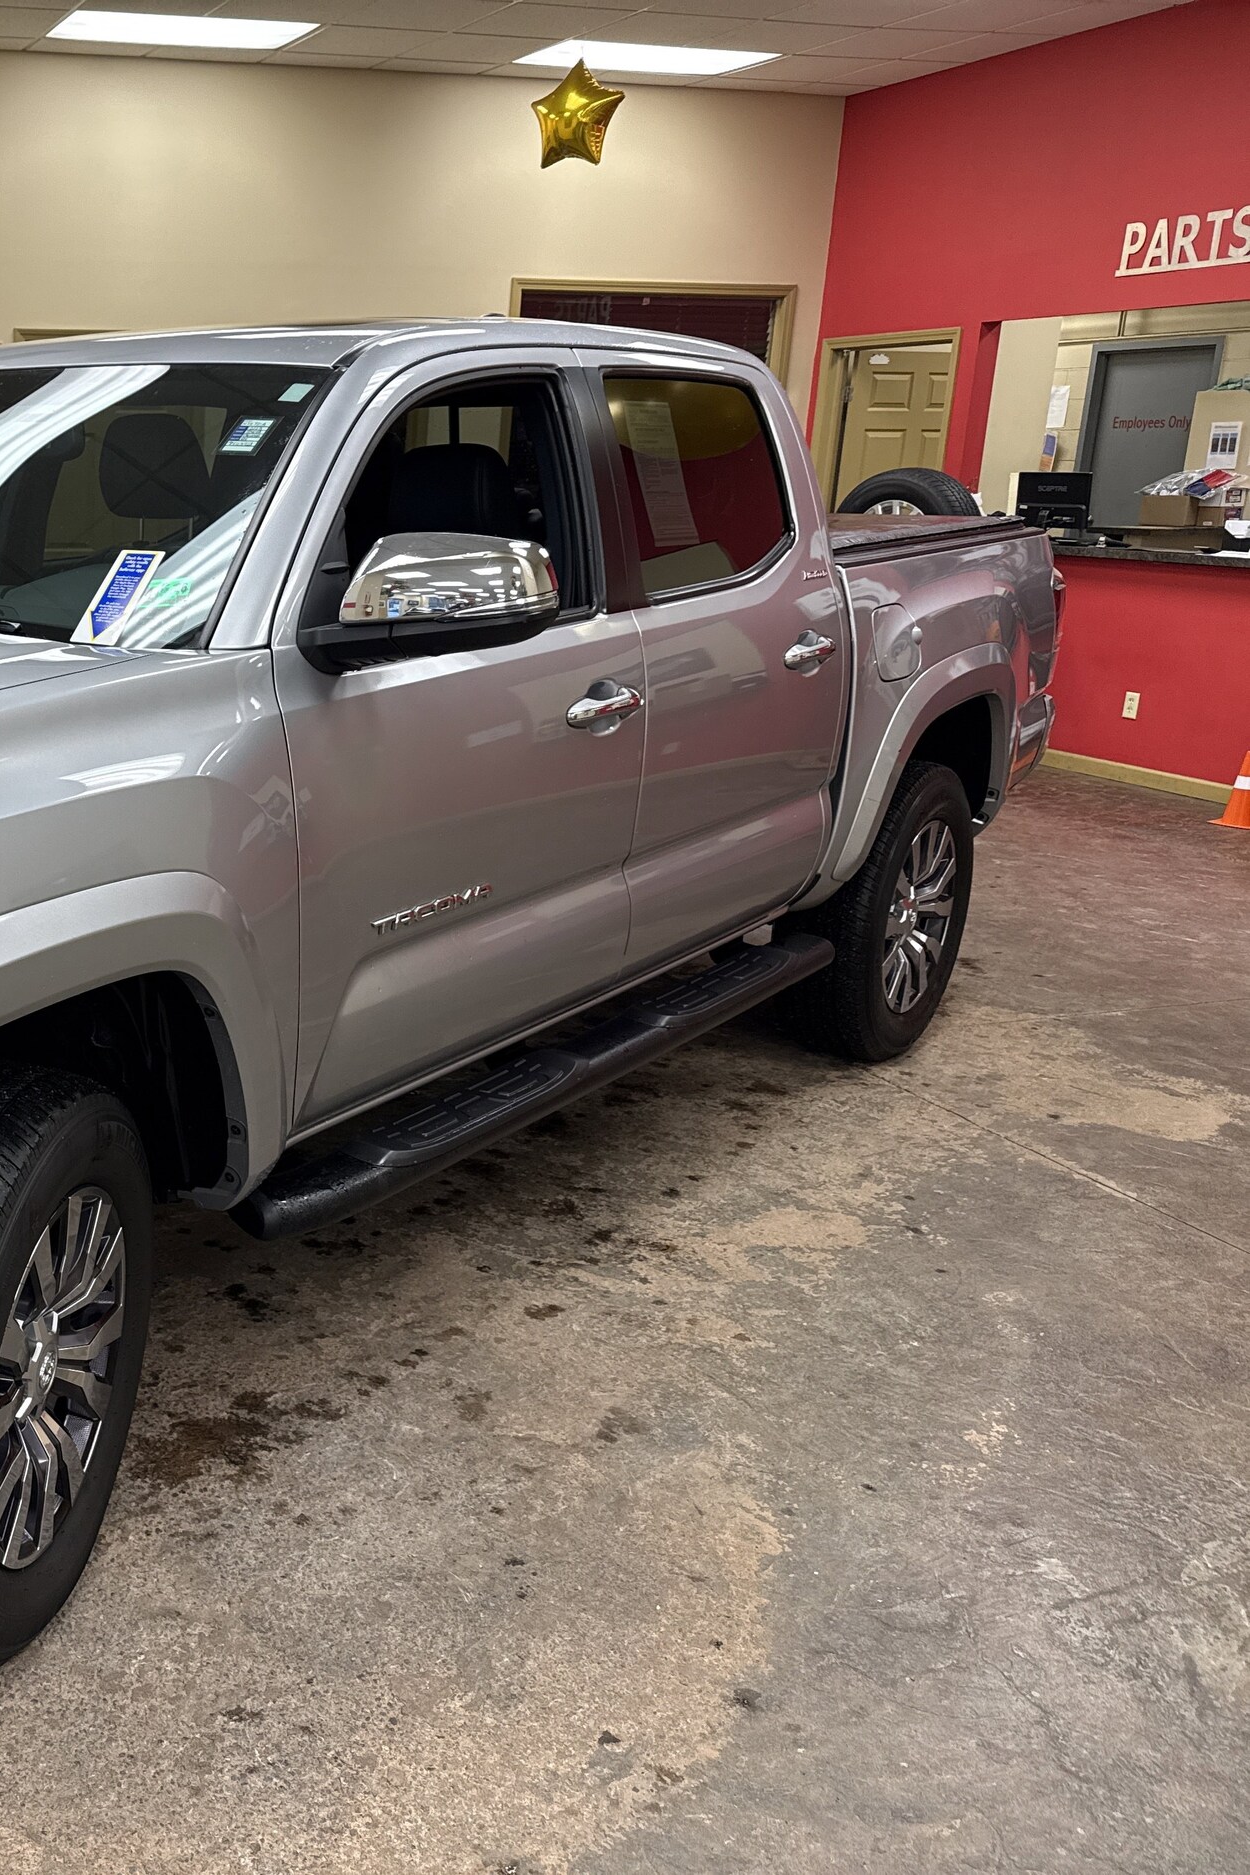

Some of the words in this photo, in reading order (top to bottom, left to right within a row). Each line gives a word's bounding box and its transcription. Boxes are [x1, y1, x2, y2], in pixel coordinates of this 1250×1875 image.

[1117, 205, 1250, 272] PARTS
[1113, 416, 1166, 432] Employees
[1169, 415, 1191, 432] Only
[370, 883, 493, 935] TACOMA
